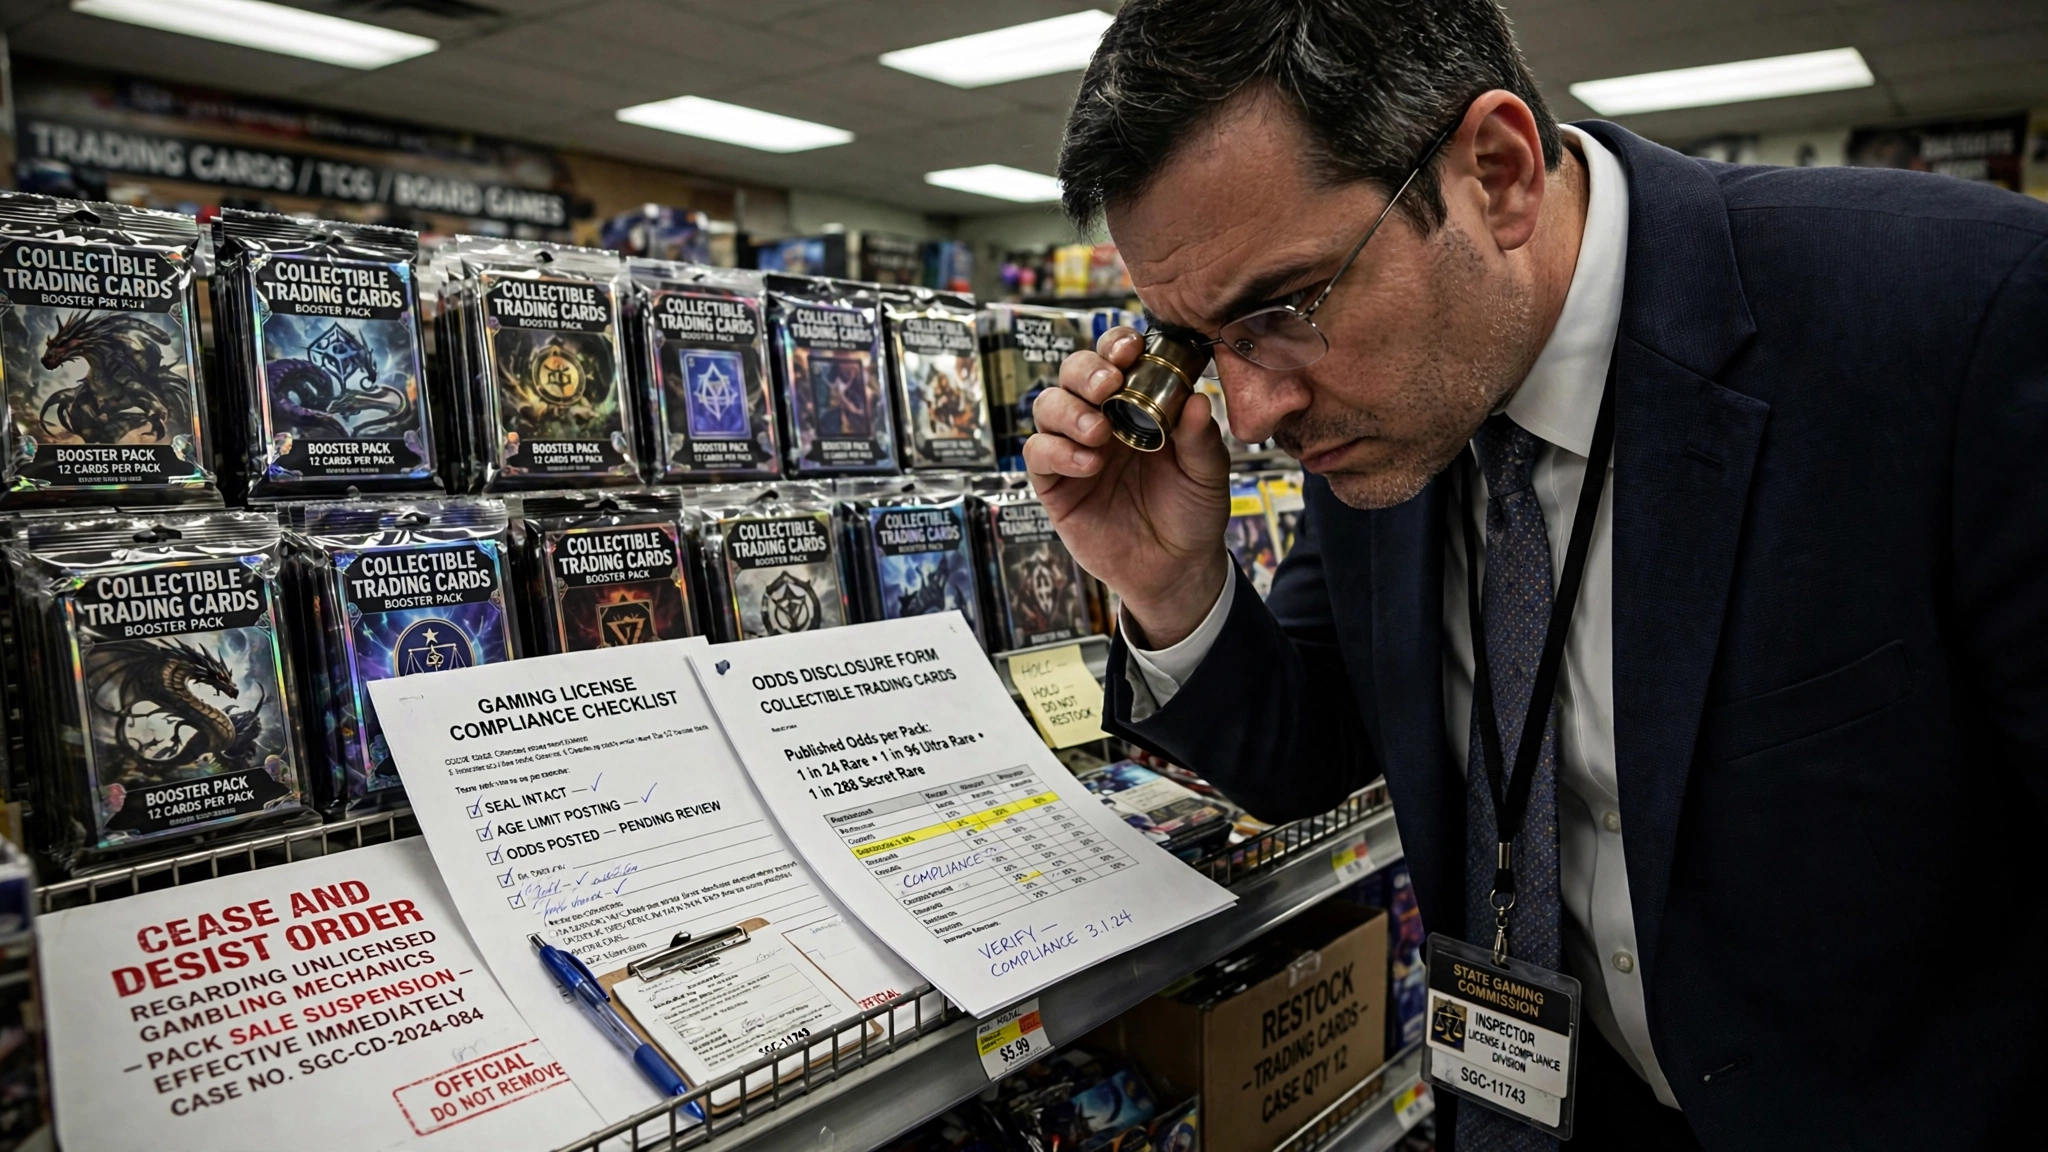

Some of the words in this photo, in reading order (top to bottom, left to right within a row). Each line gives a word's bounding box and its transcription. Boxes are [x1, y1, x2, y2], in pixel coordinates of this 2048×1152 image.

[29, 121, 186, 177] TRADING
[190, 145, 295, 190] CARDS
[317, 161, 375, 200] TCG
[394, 172, 482, 215] BOARD
[485, 186, 565, 226] GAMES
[17, 246, 157, 276] COLLECTIBLE
[276, 261, 389, 288] COLLECTIBLE
[3, 268, 100, 294] TRADING
[105, 276, 172, 298] CARDS
[264, 282, 343, 304] TRADING
[347, 288, 402, 308] CARDS
[502, 281, 596, 304] COLLECTIBLE
[42, 294, 94, 307] BOOSTER
[296, 304, 342, 315] BOOSTER
[345, 307, 371, 317] PACK
[494, 299, 557, 318] TRADING
[561, 303, 606, 322] CARDS
[666, 298, 745, 318] COLLECTIBLE
[520, 318, 558, 328] BOOSTER
[561, 320, 583, 330] PACK
[659, 314, 713, 332] TRADING
[716, 316, 754, 335] CARDS
[797, 309, 864, 328] COLLECTIBLE
[57, 449, 118, 461] BOOSTER
[122, 450, 156, 461] PACK
[308, 443, 359, 454] BOOSTER
[362, 443, 390, 454] PACK
[310, 457, 320, 465] 12
[323, 456, 352, 465] CARDS
[354, 456, 371, 464] PER
[373, 456, 395, 464] PACK
[532, 443, 575, 453] BOOSTER
[576, 443, 600, 453] PACK
[58, 465, 71, 474] 12
[74, 464, 109, 473] CARDS
[112, 464, 132, 473] PER
[135, 463, 161, 473] PACK
[739, 521, 816, 540] COLLECTIBLE
[880, 529, 925, 545] TRADING
[927, 525, 960, 542] CARDS
[885, 511, 951, 529] COLLECTIBLE
[567, 532, 661, 555] COLLECTIBLE
[733, 540, 785, 558] TRADING
[789, 536, 826, 553] CARDS
[361, 550, 477, 577] COLLECTIBLE
[559, 554, 623, 575] TRADING
[627, 550, 673, 569] CARDS
[755, 556, 788, 566] BOOSTER
[790, 554, 808, 563] PACK
[97, 568, 242, 600] COLLECTIBLE
[352, 575, 431, 599] TRADING
[436, 570, 491, 591] CARDS
[586, 572, 625, 584] BOOSTER
[628, 570, 650, 580] PACK
[83, 597, 185, 626] TRADING
[190, 590, 259, 616] CARDS
[385, 597, 433, 609] BOOSTER
[437, 593, 463, 603] PACK
[125, 620, 186, 637] BOOSTER
[191, 617, 224, 629] PACK
[752, 671, 798, 691] ODDS
[800, 655, 896, 682] DISCLOSURE
[896, 648, 939, 667] FORM
[478, 689, 557, 714] GAMING
[560, 677, 637, 701] LICENSE
[760, 686, 855, 714] COLLECTIBLE
[855, 676, 913, 697] TRADING
[914, 668, 957, 686] CARDS
[1031, 684, 1060, 699] HOLD
[1041, 700, 1054, 713] DO
[1059, 696, 1077, 708] NOT
[450, 707, 579, 741] COMPLIANCE
[582, 690, 678, 720] CHECKLIST
[1050, 707, 1096, 726] RESTOCK
[784, 739, 845, 761] Published
[845, 734, 878, 748] Odds
[879, 730, 898, 744] per
[899, 722, 932, 738] Pack:
[797, 769, 806, 781] 1
[808, 766, 822, 778] in
[822, 761, 840, 775] 24
[840, 757, 870, 772] Rare
[880, 751, 888, 762] 1
[889, 749, 904, 760] in
[904, 745, 920, 757] 96
[919, 739, 949, 753] Ultra
[949, 734, 976, 747] Rare
[146, 783, 209, 807] BOOSTER
[214, 776, 249, 793] PACK
[809, 788, 817, 799] 1
[819, 786, 833, 797] in
[833, 779, 859, 794] 288
[859, 771, 896, 788] Secret
[897, 764, 925, 780] Rare
[148, 808, 162, 820] 12
[164, 802, 201, 816] CARDS
[204, 796, 225, 808] PER
[228, 790, 254, 805] PACK
[485, 797, 521, 813] SEAL
[522, 787, 567, 806] INTACT
[497, 820, 526, 836] AGE
[528, 814, 562, 830] LIMIT
[567, 800, 620, 821] POSTING
[507, 842, 545, 860] ODDS
[550, 829, 600, 851] POSTED
[619, 812, 674, 834] PENDING
[676, 800, 721, 820] REVIEW
[903, 854, 983, 888] COMPLIANCE
[137, 899, 279, 953] CEASE
[290, 880, 370, 918] AND
[111, 933, 270, 998] DESIST
[285, 899, 424, 951] ORDER
[978, 925, 1037, 959] VERIFY
[991, 932, 1078, 977] COMPLIANCE
[1085, 909, 1133, 937] 3.1.24
[131, 969, 287, 1022] REGARDING
[292, 931, 436, 976] UNLICENSED
[1454, 963, 1490, 986] STATE
[1493, 977, 1543, 1005] GAMING
[140, 990, 287, 1042] GAMBLING
[293, 951, 435, 999] MECHANICS
[1262, 962, 1354, 1049] RESTOCK
[1458, 980, 1539, 1017] COMMISSION
[147, 1035, 223, 1070] PACK
[229, 1013, 298, 1045] SALE
[303, 968, 456, 1023] SUSPENSION
[1475, 1012, 1535, 1047] INSPECTOR
[154, 1037, 302, 1094] EFFECTIVE
[307, 988, 465, 1047] IMMEDIATELY
[1000, 1037, 1030, 1062] $5.99
[1254, 1030, 1315, 1089] TRADING
[1317, 1002, 1358, 1048] CARDS
[1468, 1029, 1499, 1049] LICENSE
[1509, 1044, 1560, 1072] COMPLIANCE
[170, 1081, 242, 1116] CASE
[248, 1068, 293, 1092] NO.
[299, 1007, 484, 1075] SGC-CD-2024-084
[434, 1053, 534, 1097] OFFICIAL
[1492, 1052, 1526, 1073] DIVISION
[430, 1102, 457, 1122] DO
[459, 1087, 495, 1111] NOT
[497, 1062, 565, 1096] REMOVE
[1262, 1077, 1300, 1123] CASE
[1303, 1055, 1330, 1096] QTY
[1334, 1044, 1347, 1074] 12
[1461, 1067, 1525, 1105] SGC-11743
